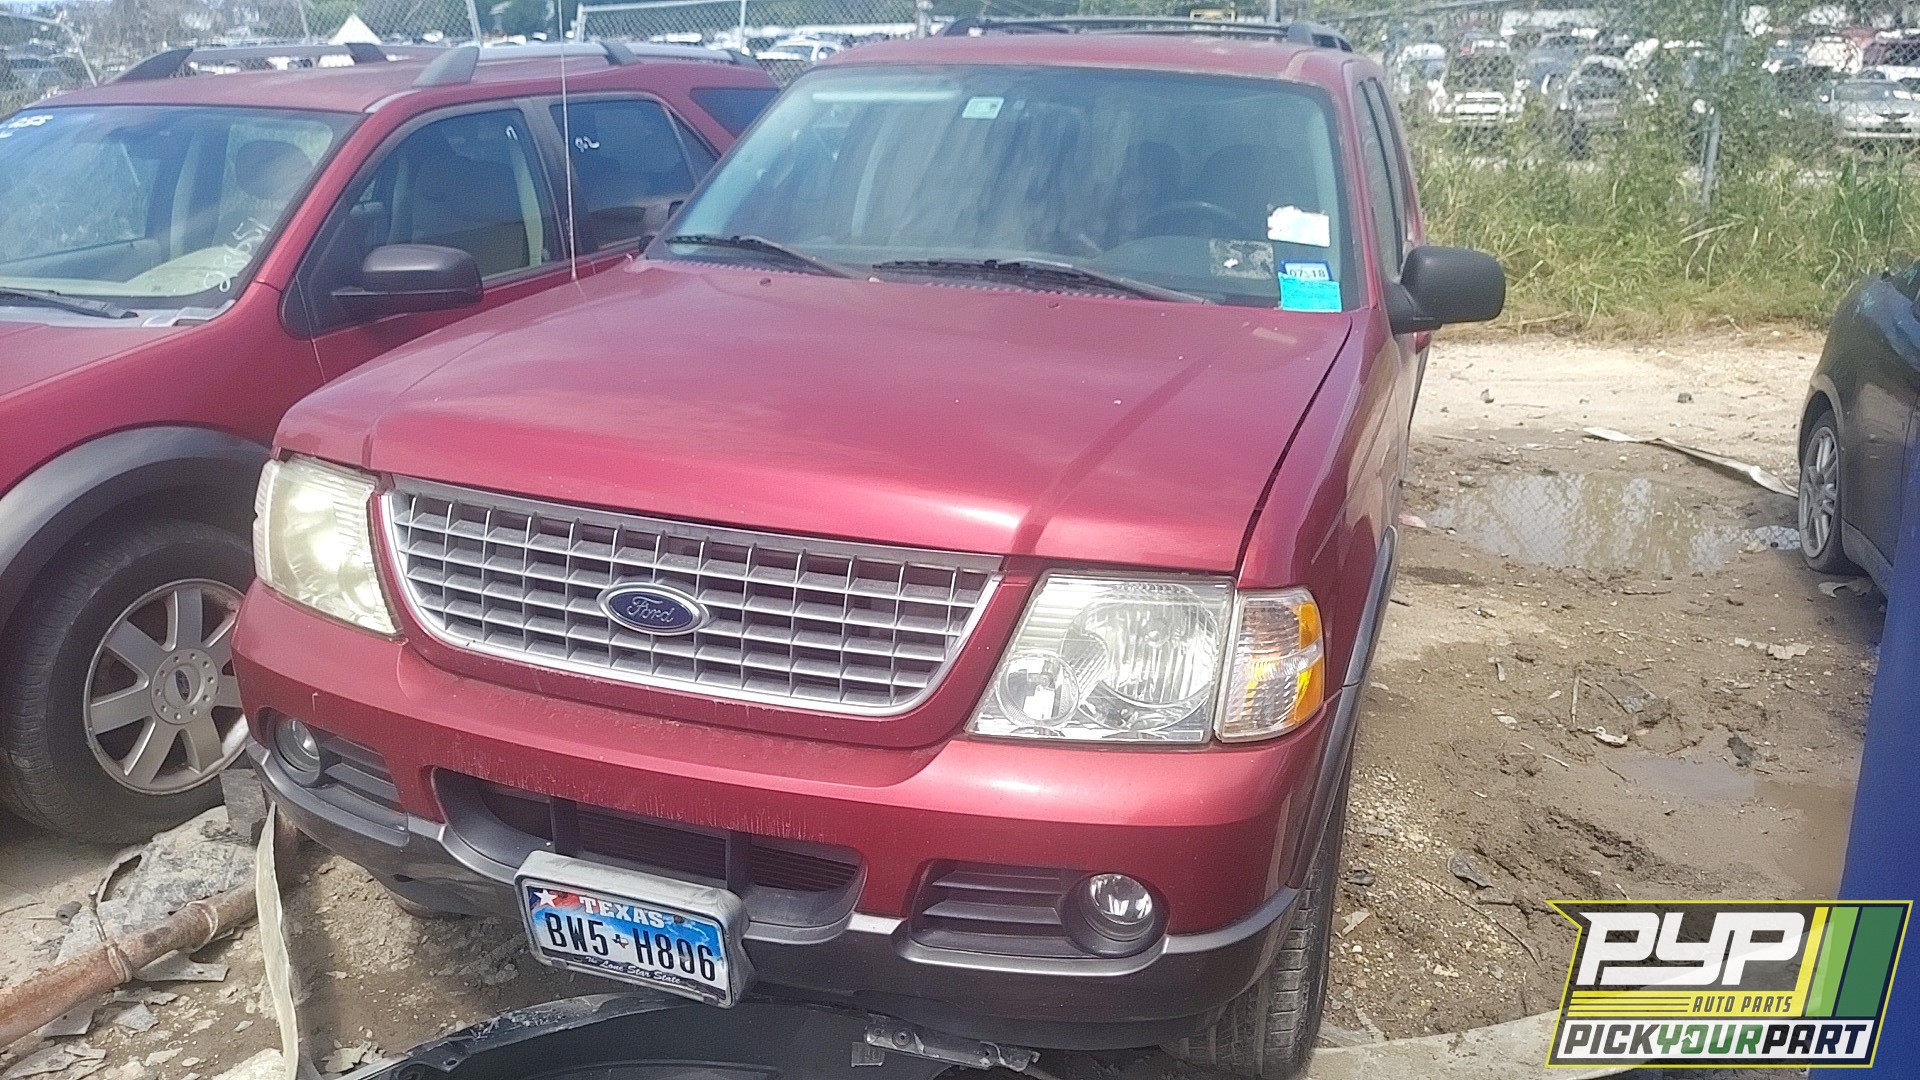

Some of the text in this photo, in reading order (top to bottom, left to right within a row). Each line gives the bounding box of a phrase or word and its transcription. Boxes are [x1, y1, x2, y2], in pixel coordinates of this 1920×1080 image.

[626, 596, 675, 622] Ford
[579, 896, 664, 928] TEXAS
[545, 912, 609, 956] BW5
[600, 960, 624, 972] Lone
[627, 965, 651, 978] Star
[653, 971, 681, 984] State
